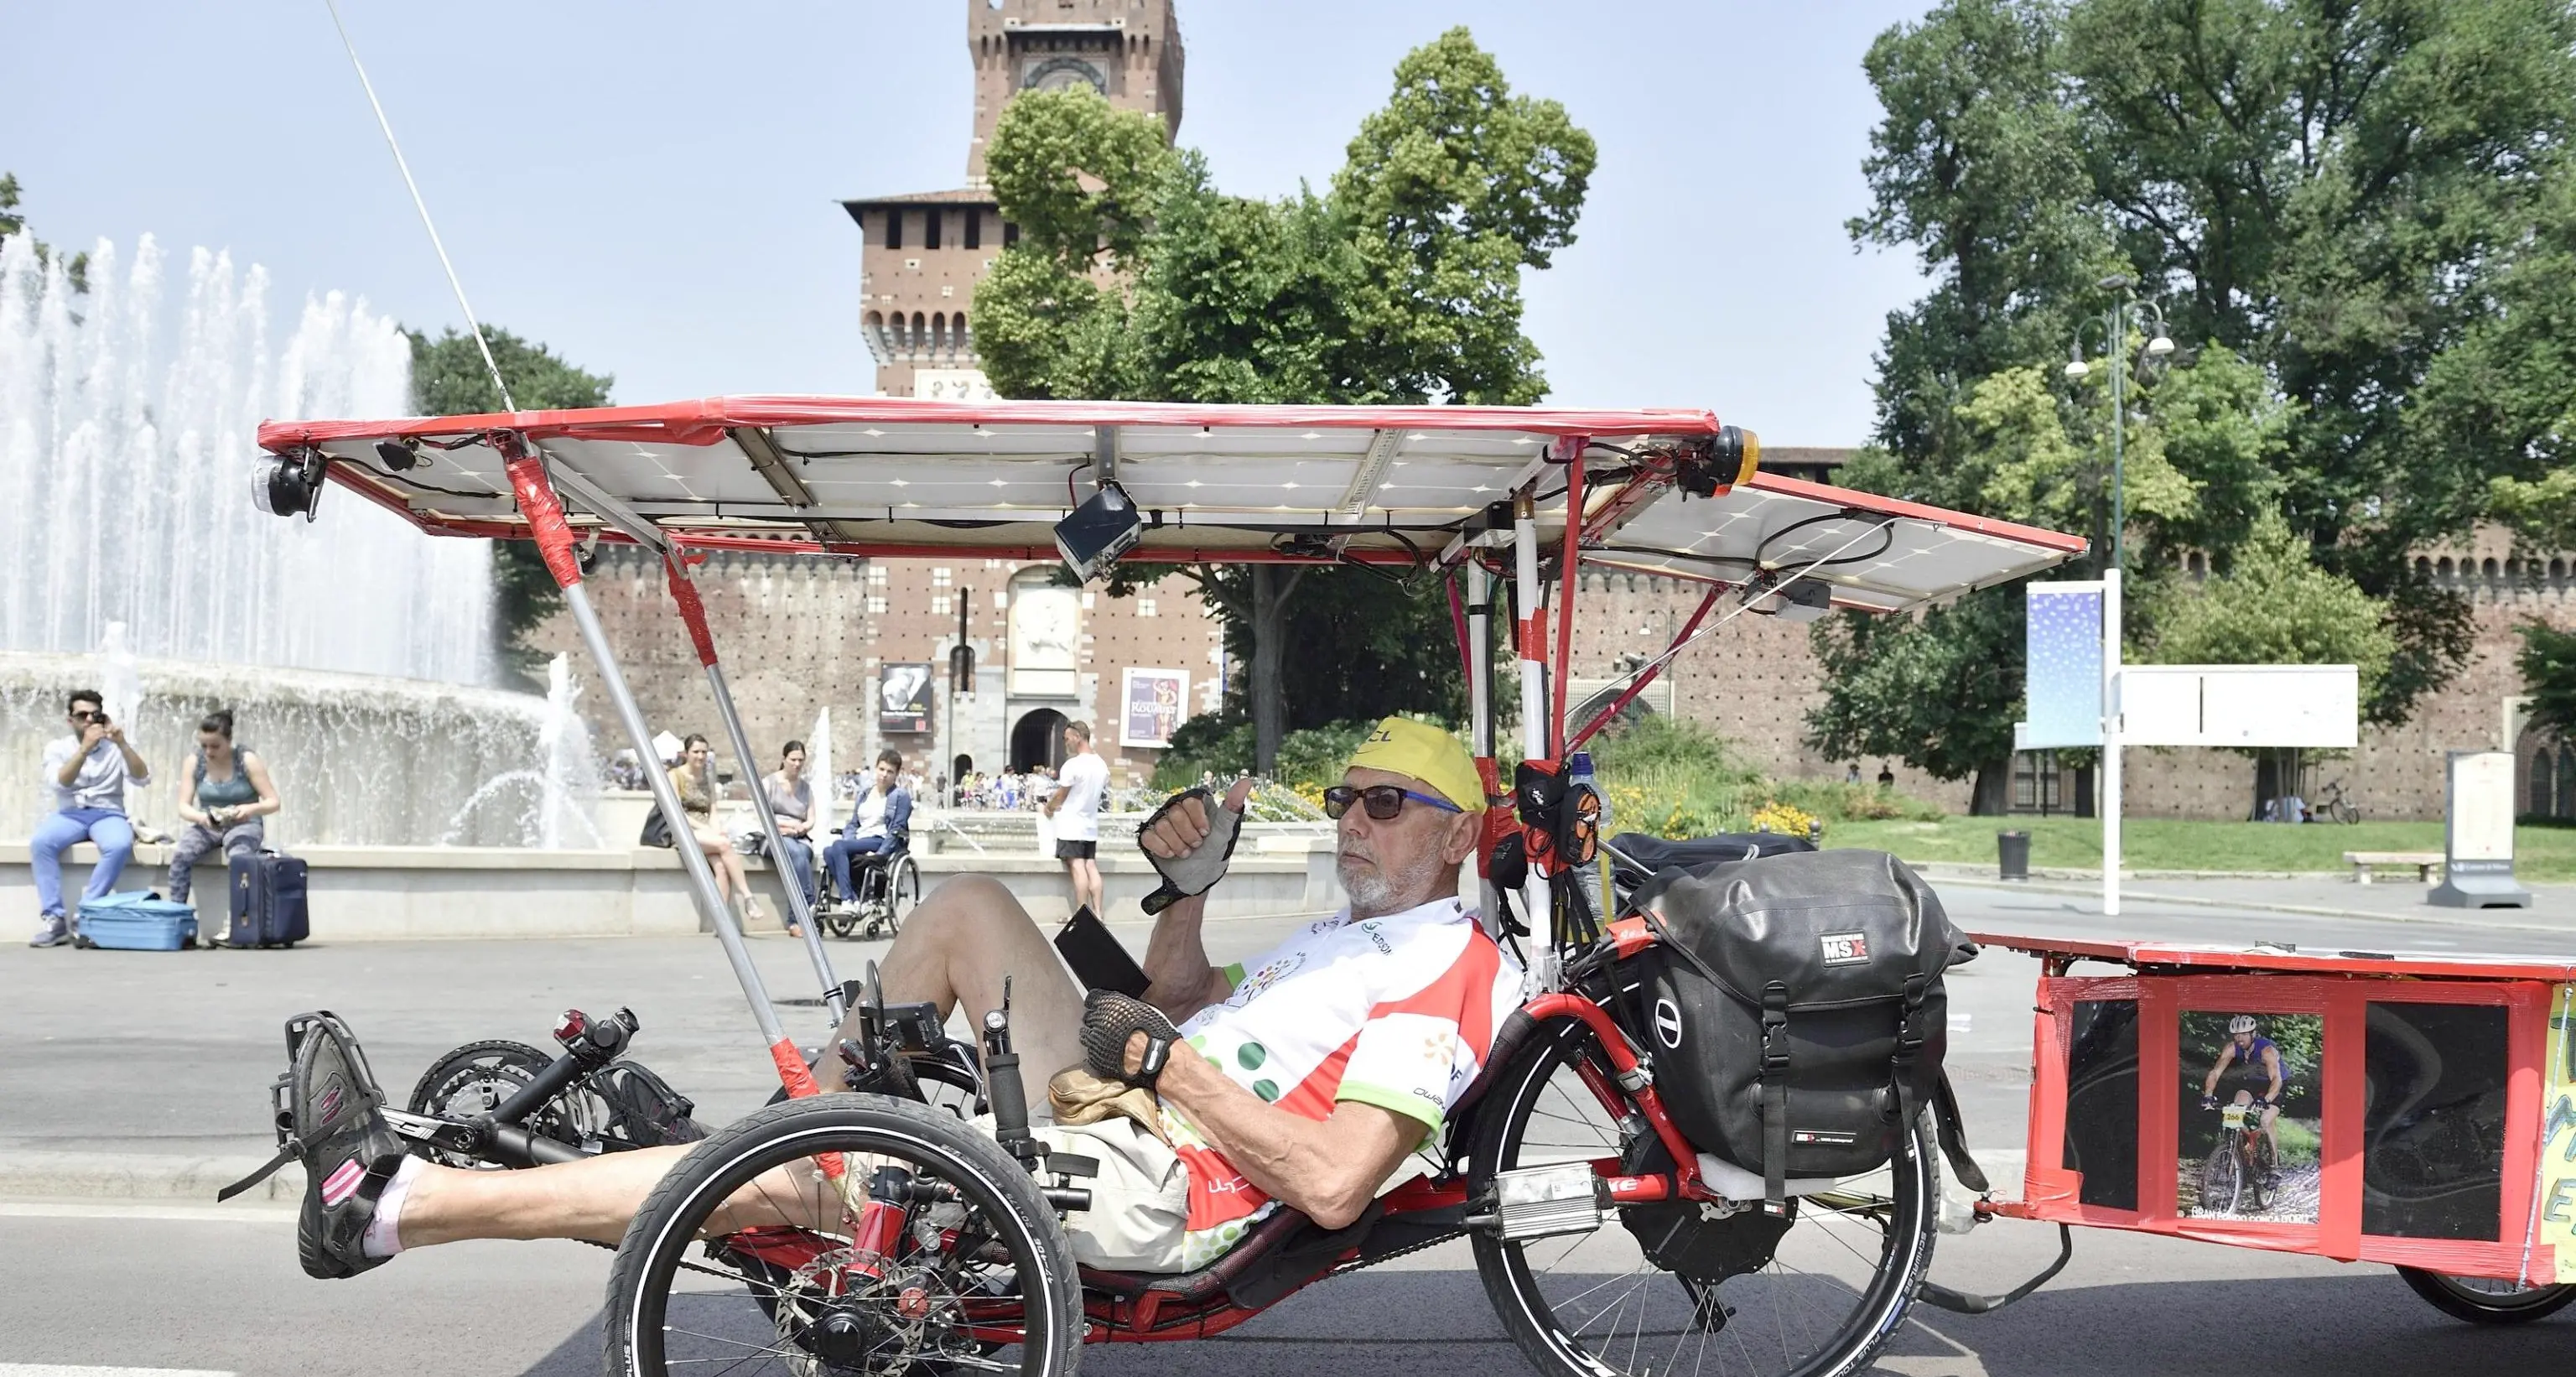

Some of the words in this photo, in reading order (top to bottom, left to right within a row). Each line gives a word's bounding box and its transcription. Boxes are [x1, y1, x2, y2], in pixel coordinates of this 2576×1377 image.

[1822, 939, 1867, 959] MSX
[1903, 1230, 1927, 1296] SCHWALBE
[1857, 1333, 1881, 1360] PLUS
